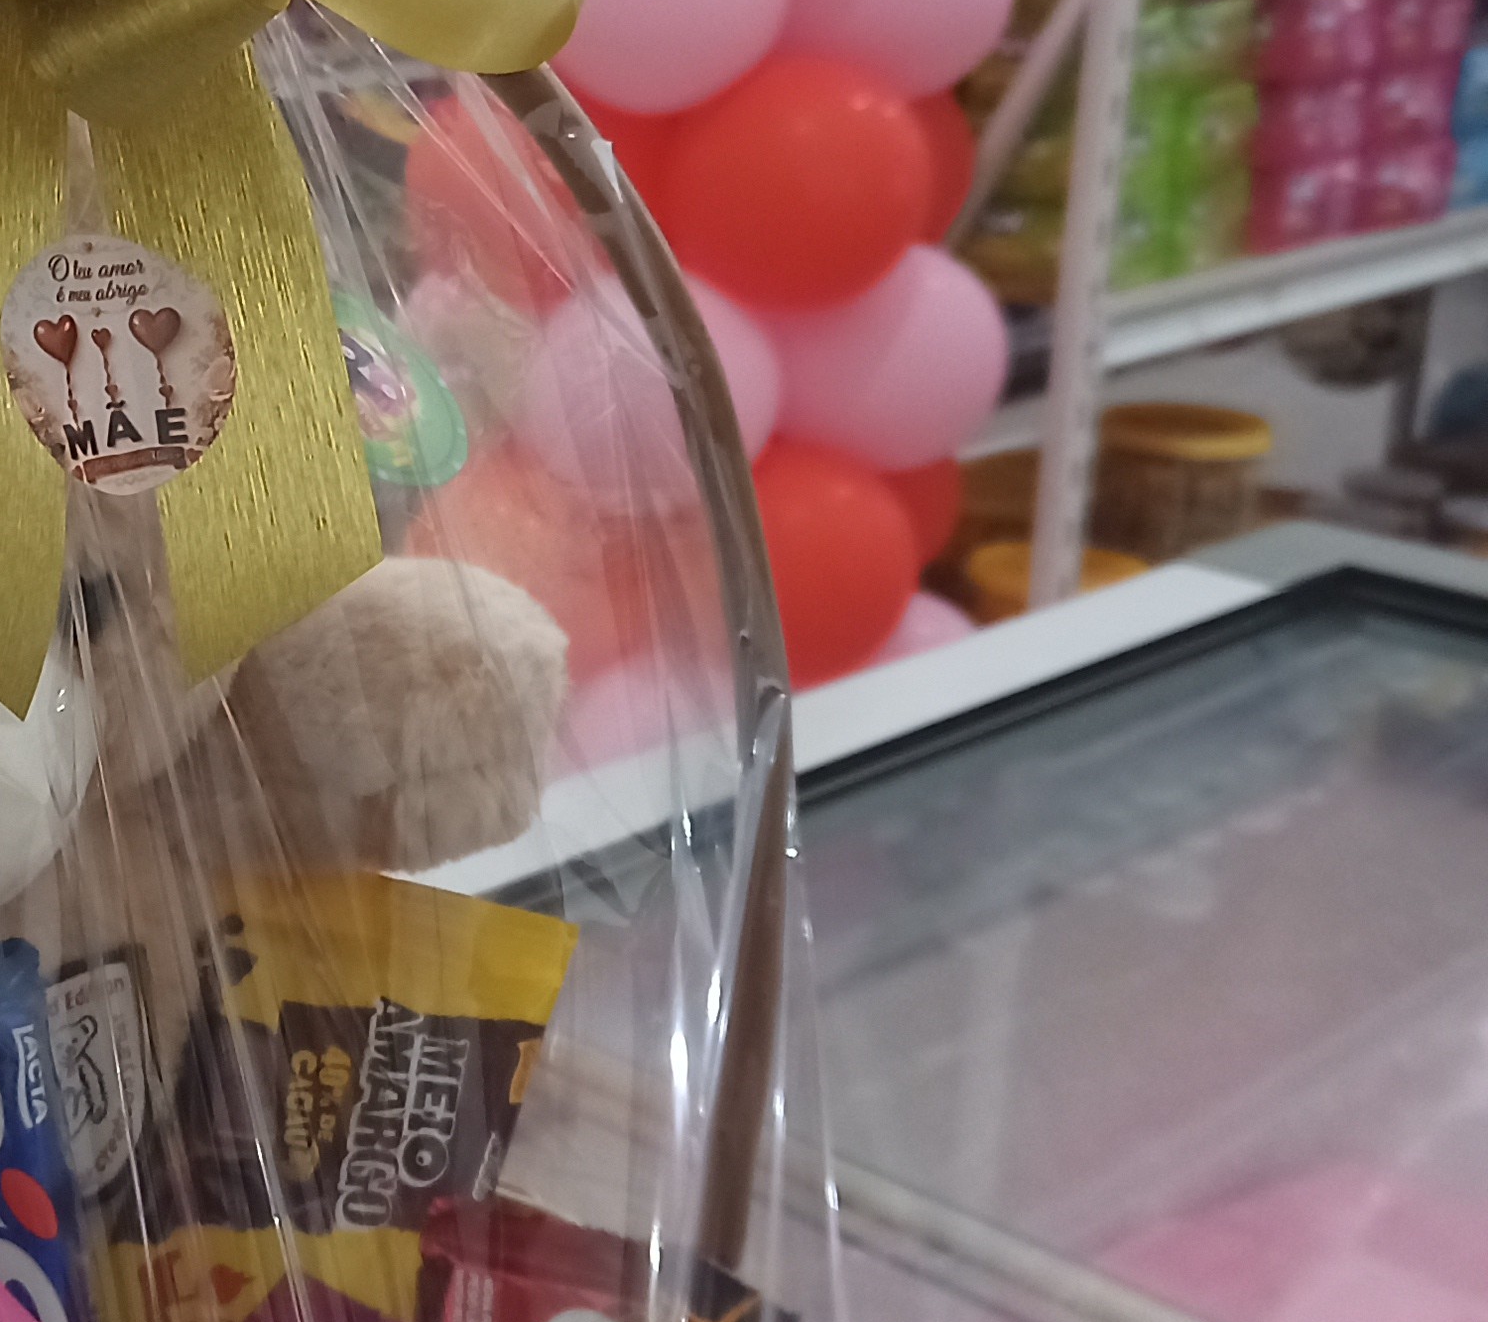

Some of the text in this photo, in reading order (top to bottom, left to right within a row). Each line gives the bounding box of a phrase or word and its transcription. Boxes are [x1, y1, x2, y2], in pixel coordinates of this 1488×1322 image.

[68, 288, 91, 301] meu
[95, 280, 149, 305] abrigo
[98, 258, 145, 278] amor
[63, 400, 189, 460] MÃE
[13, 1023, 48, 1129] LACTA
[335, 996, 424, 1231] AMARGO
[398, 1033, 469, 1188] MEIO
